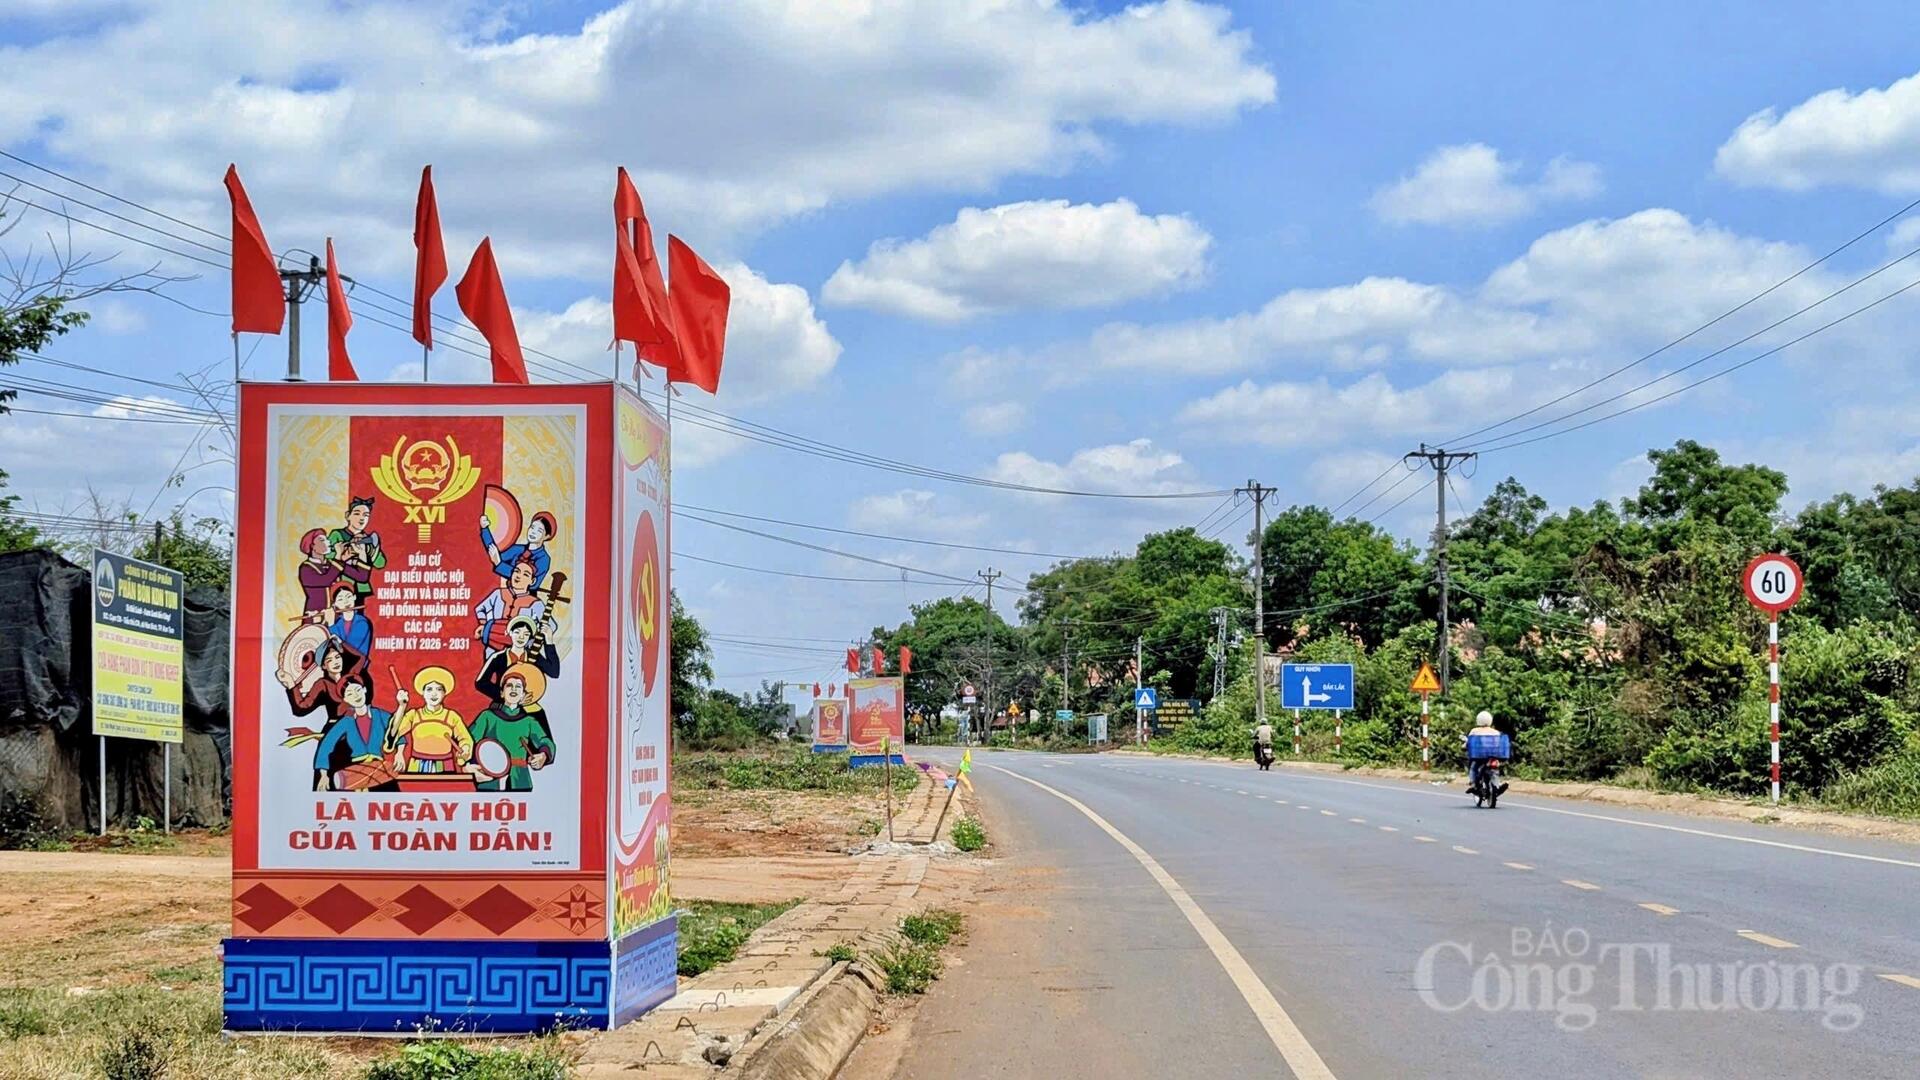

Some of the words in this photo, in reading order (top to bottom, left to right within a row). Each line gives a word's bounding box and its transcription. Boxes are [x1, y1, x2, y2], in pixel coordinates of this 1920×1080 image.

[403, 506, 446, 524] XVI
[429, 550, 442, 567] CỬ
[384, 571, 399, 586] ĐẠI
[401, 567, 422, 584] BIỂU
[424, 568, 447, 584] QUỐC
[449, 569, 464, 586] HỘI
[1762, 570, 1786, 594] 60
[378, 584, 401, 600] KHÓA
[403, 588, 418, 600] XVI
[420, 585, 431, 600] VÀ
[433, 588, 448, 602] ĐẠI
[450, 584, 470, 600] BIỂU
[379, 602, 394, 619] HỘI
[423, 602, 447, 616] NHÂN
[449, 602, 468, 616] DÂN
[404, 619, 422, 634] CÁC
[424, 617, 442, 634] CẤP
[375, 636, 404, 652] NHIỆM
[420, 638, 441, 650] 2026
[449, 638, 469, 650] 2031
[316, 797, 356, 822] LÀ
[368, 798, 459, 822] NGÀY
[471, 798, 527, 826] HỘI
[289, 823, 357, 850] CỦA
[368, 827, 457, 850] TOÀN
[469, 826, 552, 851] DÂN!
